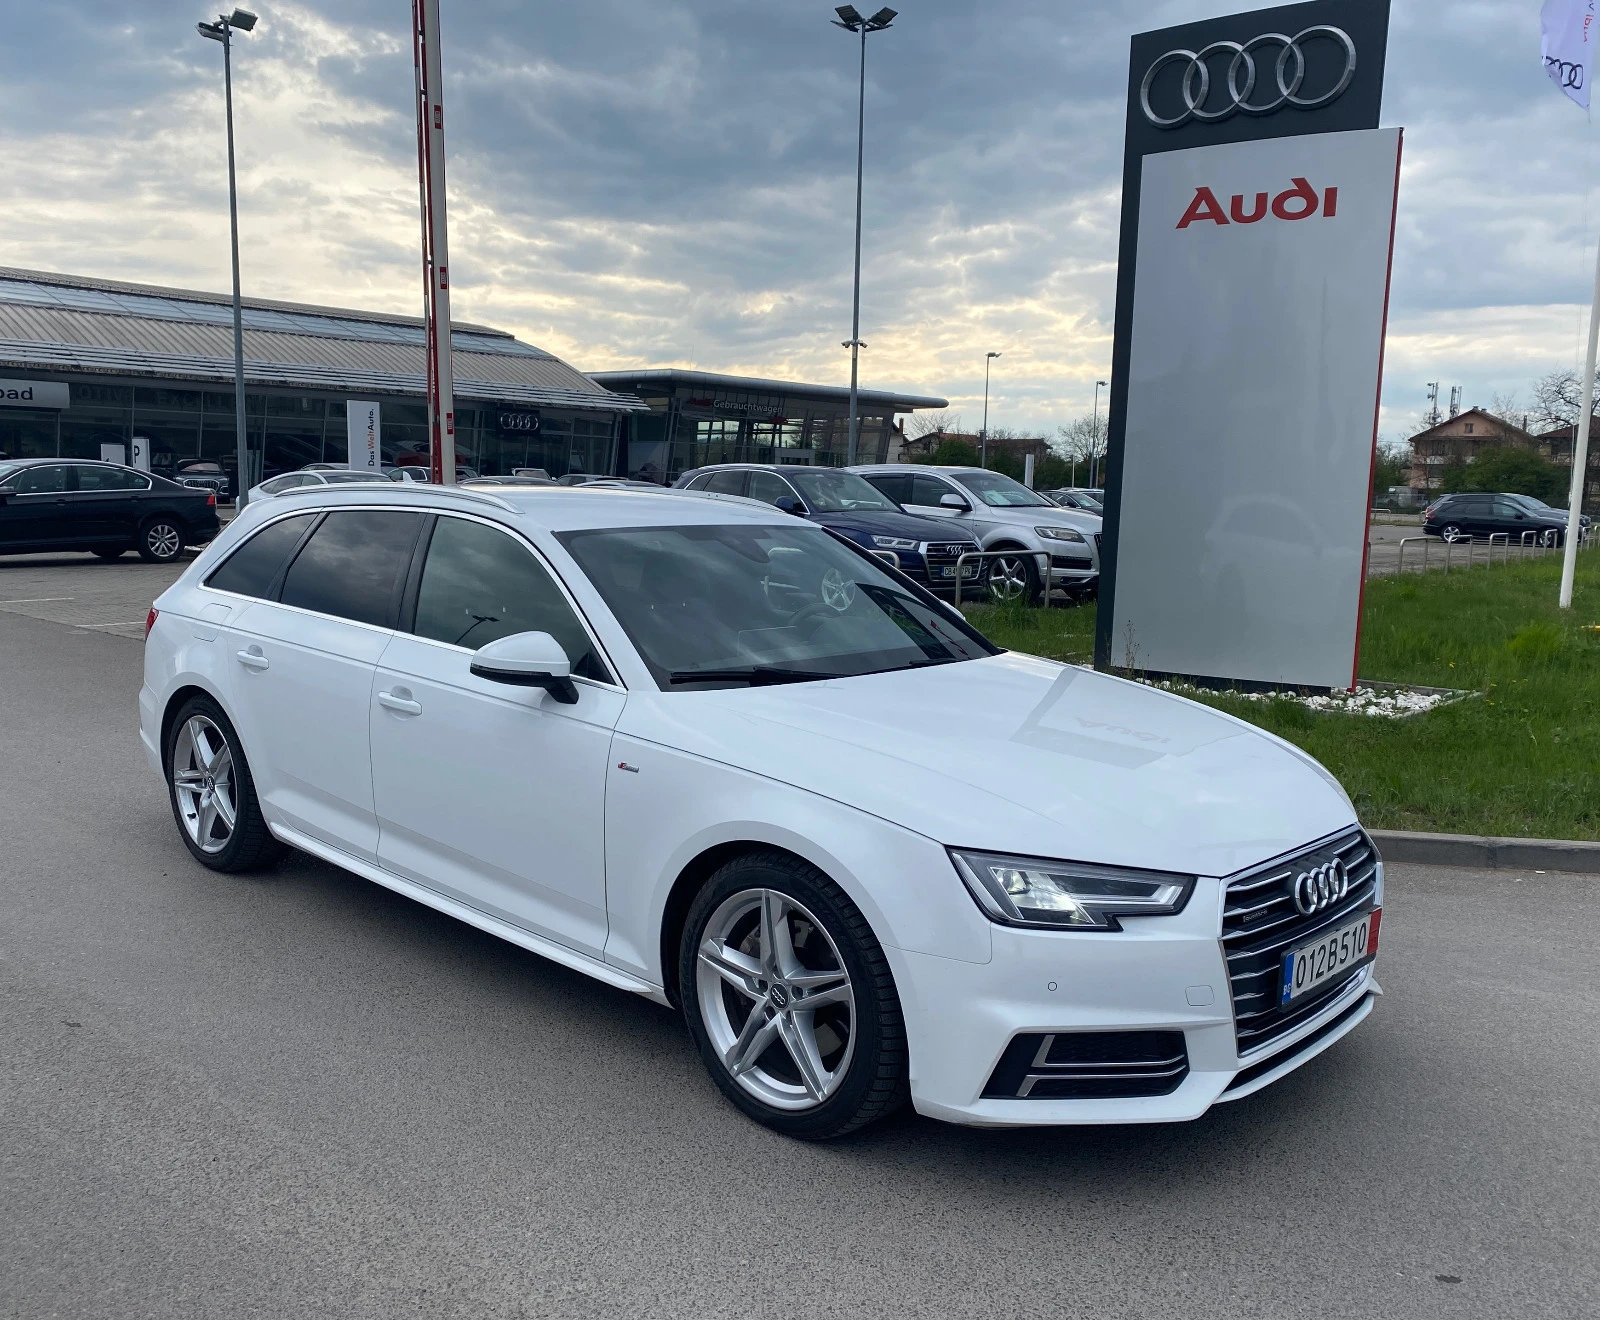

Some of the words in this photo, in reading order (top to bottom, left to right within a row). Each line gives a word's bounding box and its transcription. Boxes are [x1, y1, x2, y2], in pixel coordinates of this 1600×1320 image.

[1175, 177, 1338, 229] Audi
[713, 399, 783, 414] Gebrauchtwagen
[1296, 922, 1367, 988] 012B510
